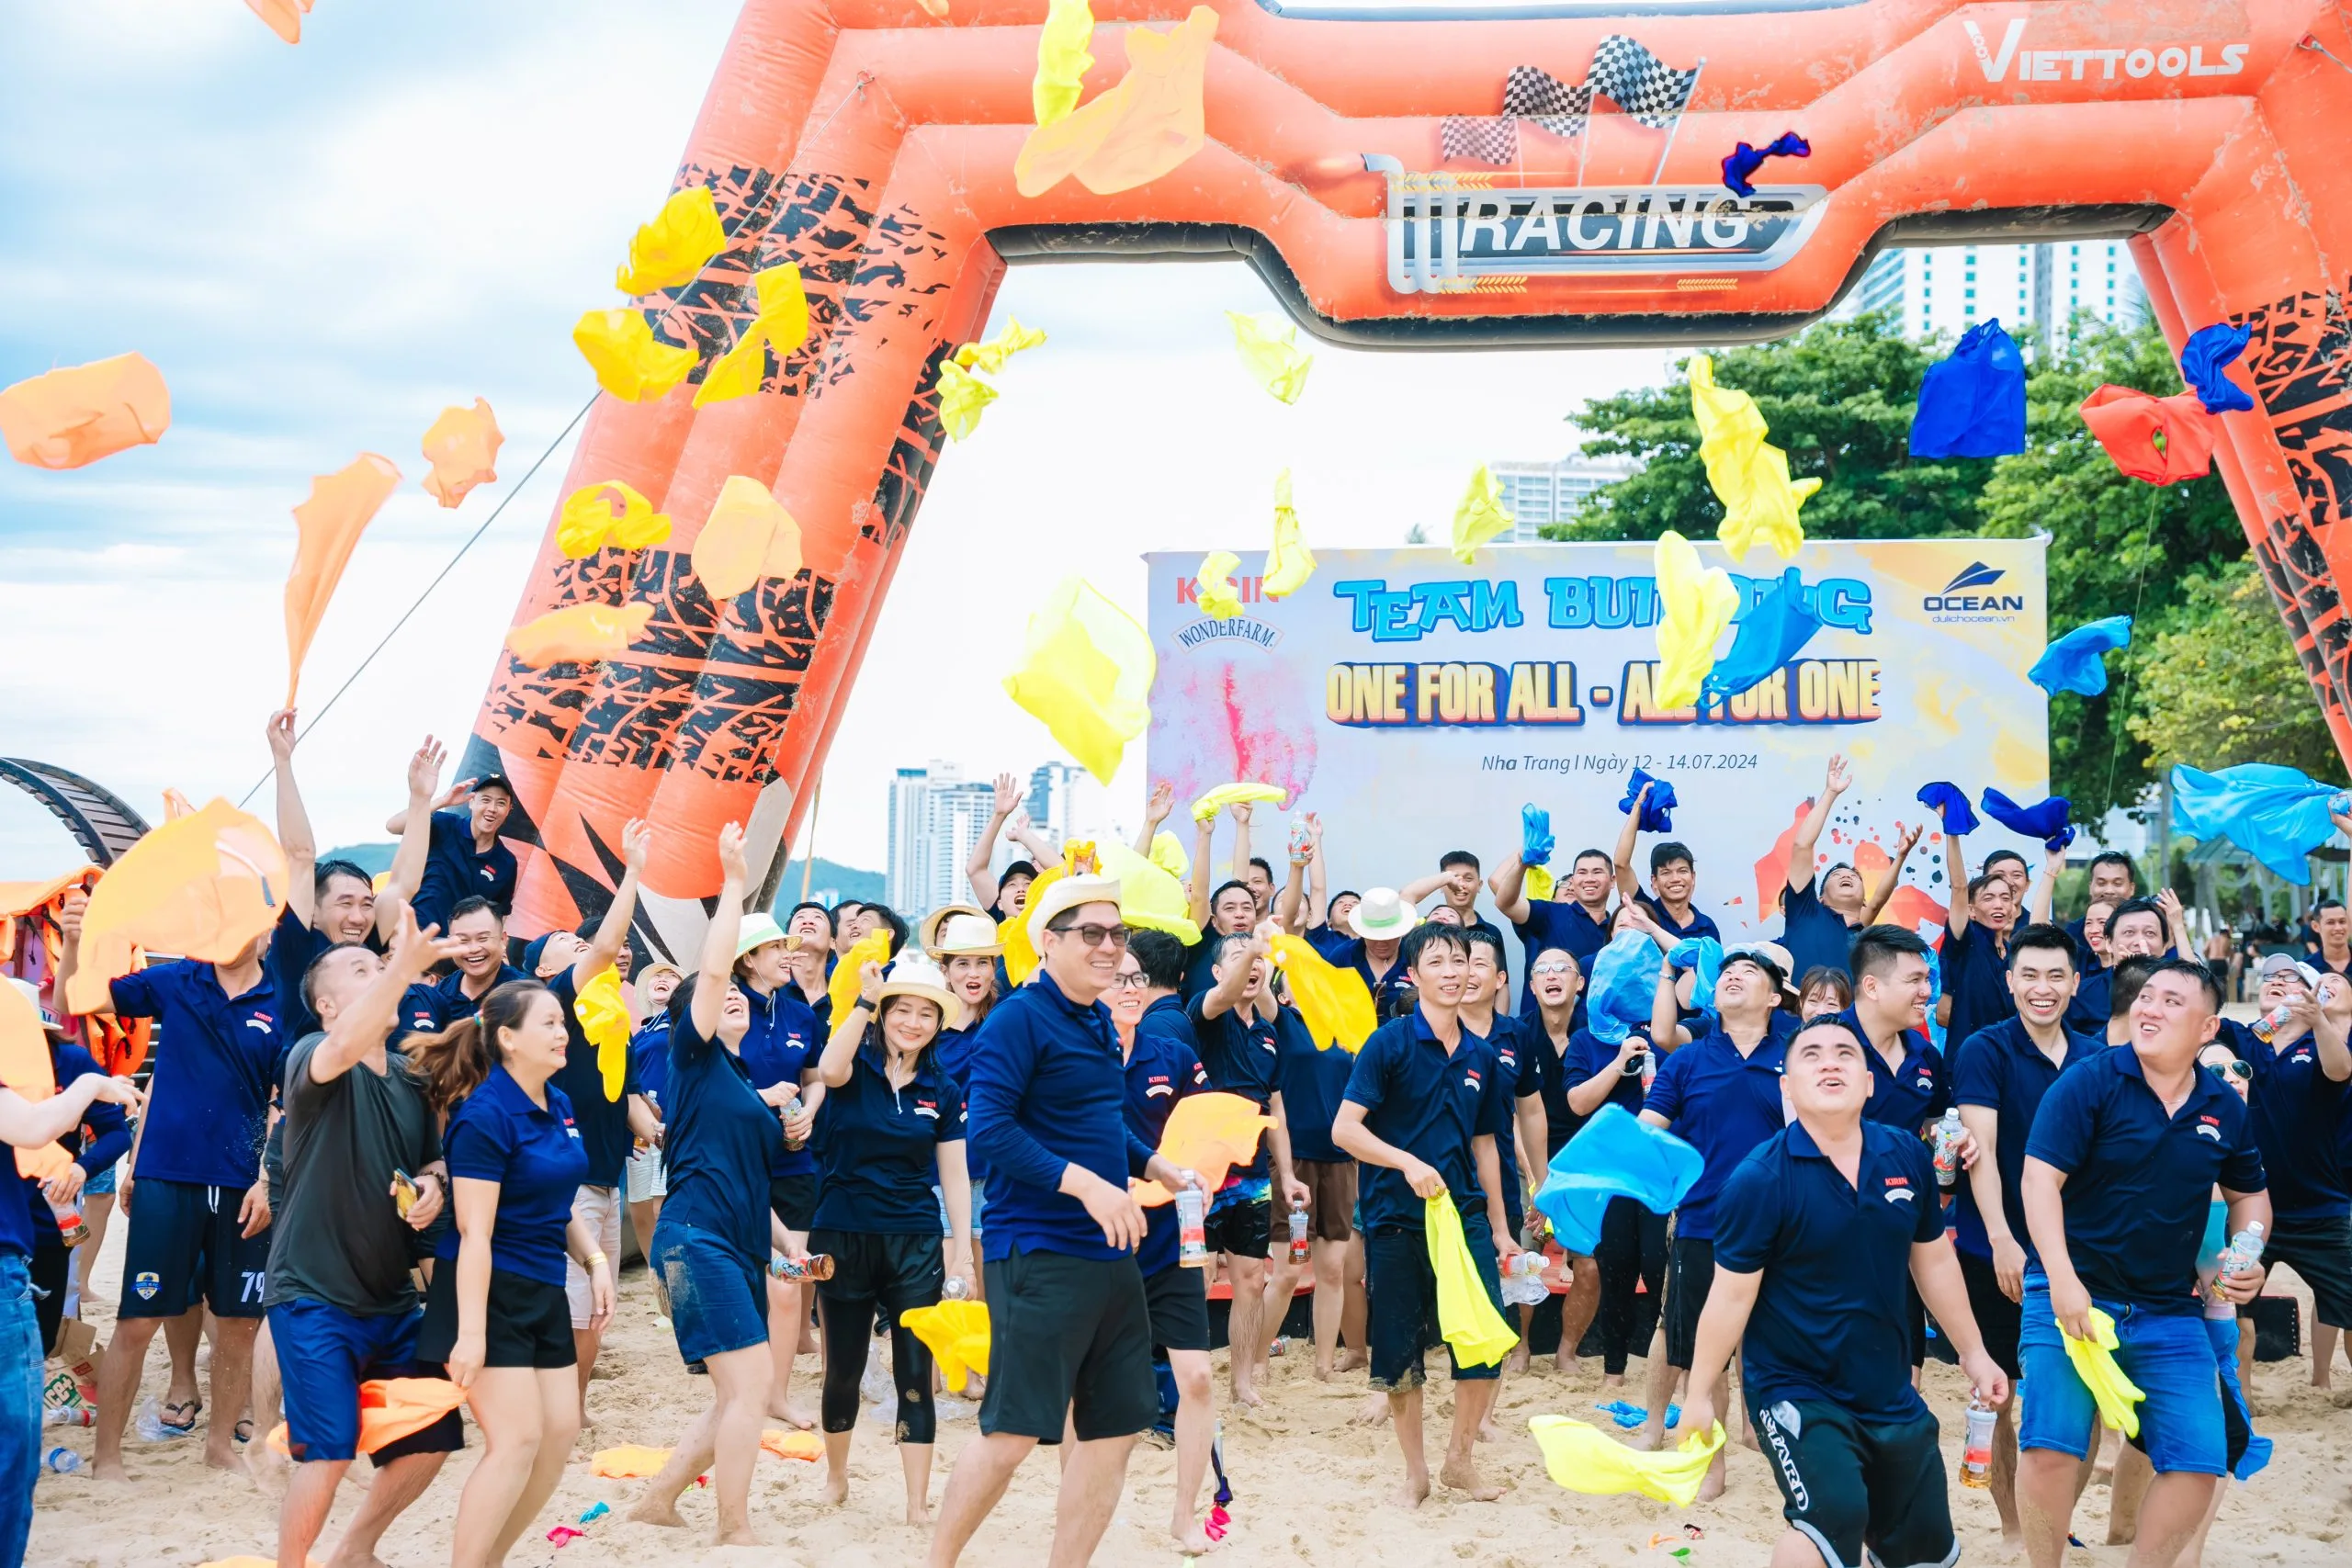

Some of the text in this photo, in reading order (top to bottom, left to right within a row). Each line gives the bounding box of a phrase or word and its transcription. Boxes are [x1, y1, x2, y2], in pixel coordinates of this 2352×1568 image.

[1962, 18, 2249, 83] VIETTOOLS
[1459, 191, 1750, 251] RACING
[1334, 580, 1523, 642] TEAM
[1924, 596, 2023, 611] OCEAN
[1932, 614, 2015, 623] dulichocean.vn
[1179, 618, 1275, 648] WONDERFARM
[1326, 662, 1408, 723] ONE
[1418, 662, 1497, 723] FOR
[1506, 662, 1581, 723] ALL
[1708, 663, 1789, 723] OR
[1799, 660, 1881, 720] ONE
[1482, 755, 1517, 770] Nha
[1523, 755, 1570, 774] Trang
[1584, 753, 1628, 774] Ngày
[1633, 754, 1652, 769] 12
[1667, 754, 1758, 770] 14.07.2024
[1885, 1177, 1908, 1186] KIRIN
